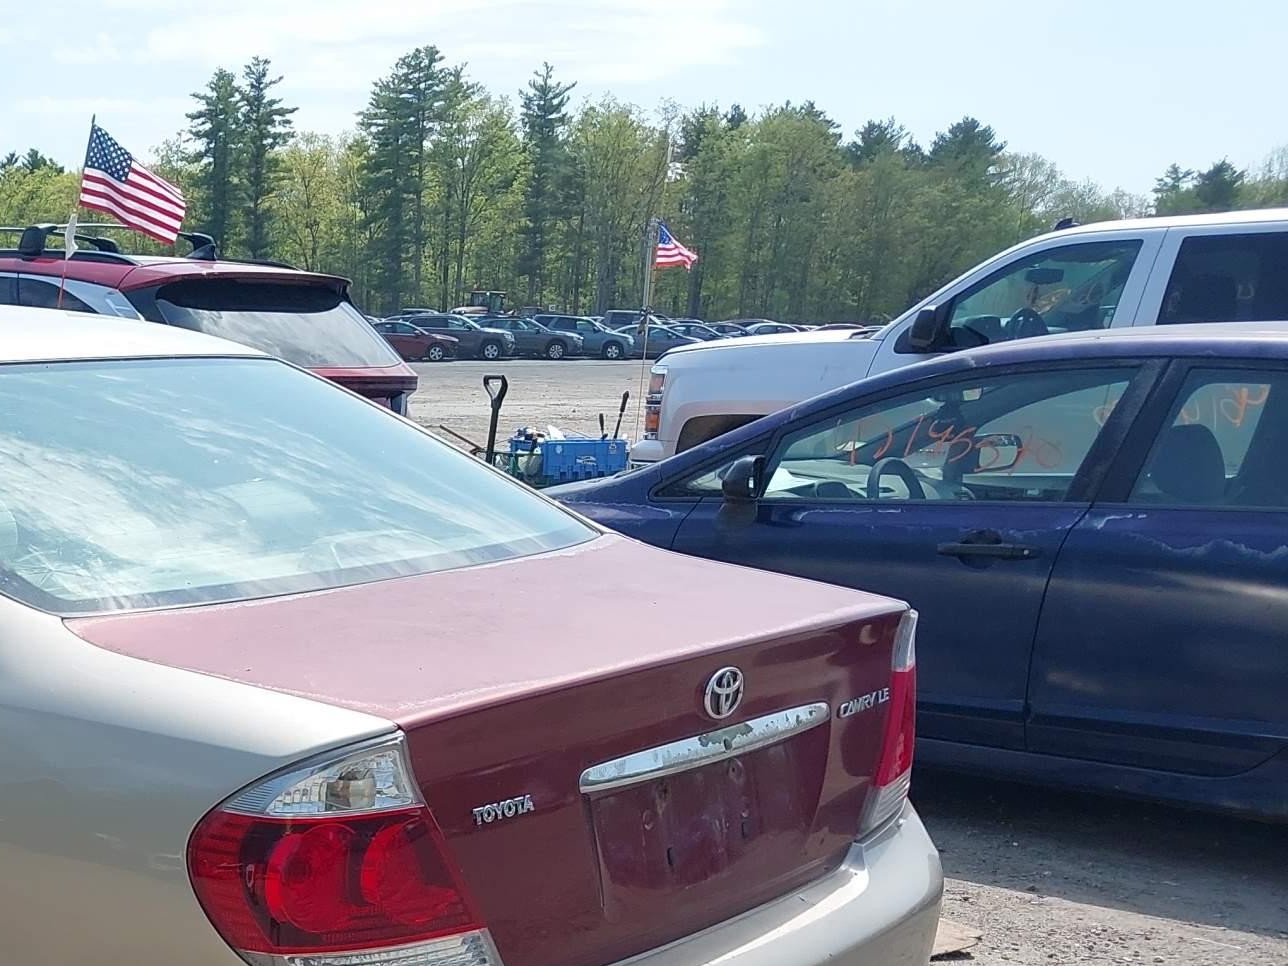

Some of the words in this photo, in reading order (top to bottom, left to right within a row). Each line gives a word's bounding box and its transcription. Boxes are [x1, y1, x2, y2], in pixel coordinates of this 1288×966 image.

[839, 691, 877, 718] CAMRY
[878, 687, 890, 704] LE
[472, 794, 535, 826] TOYOTA
